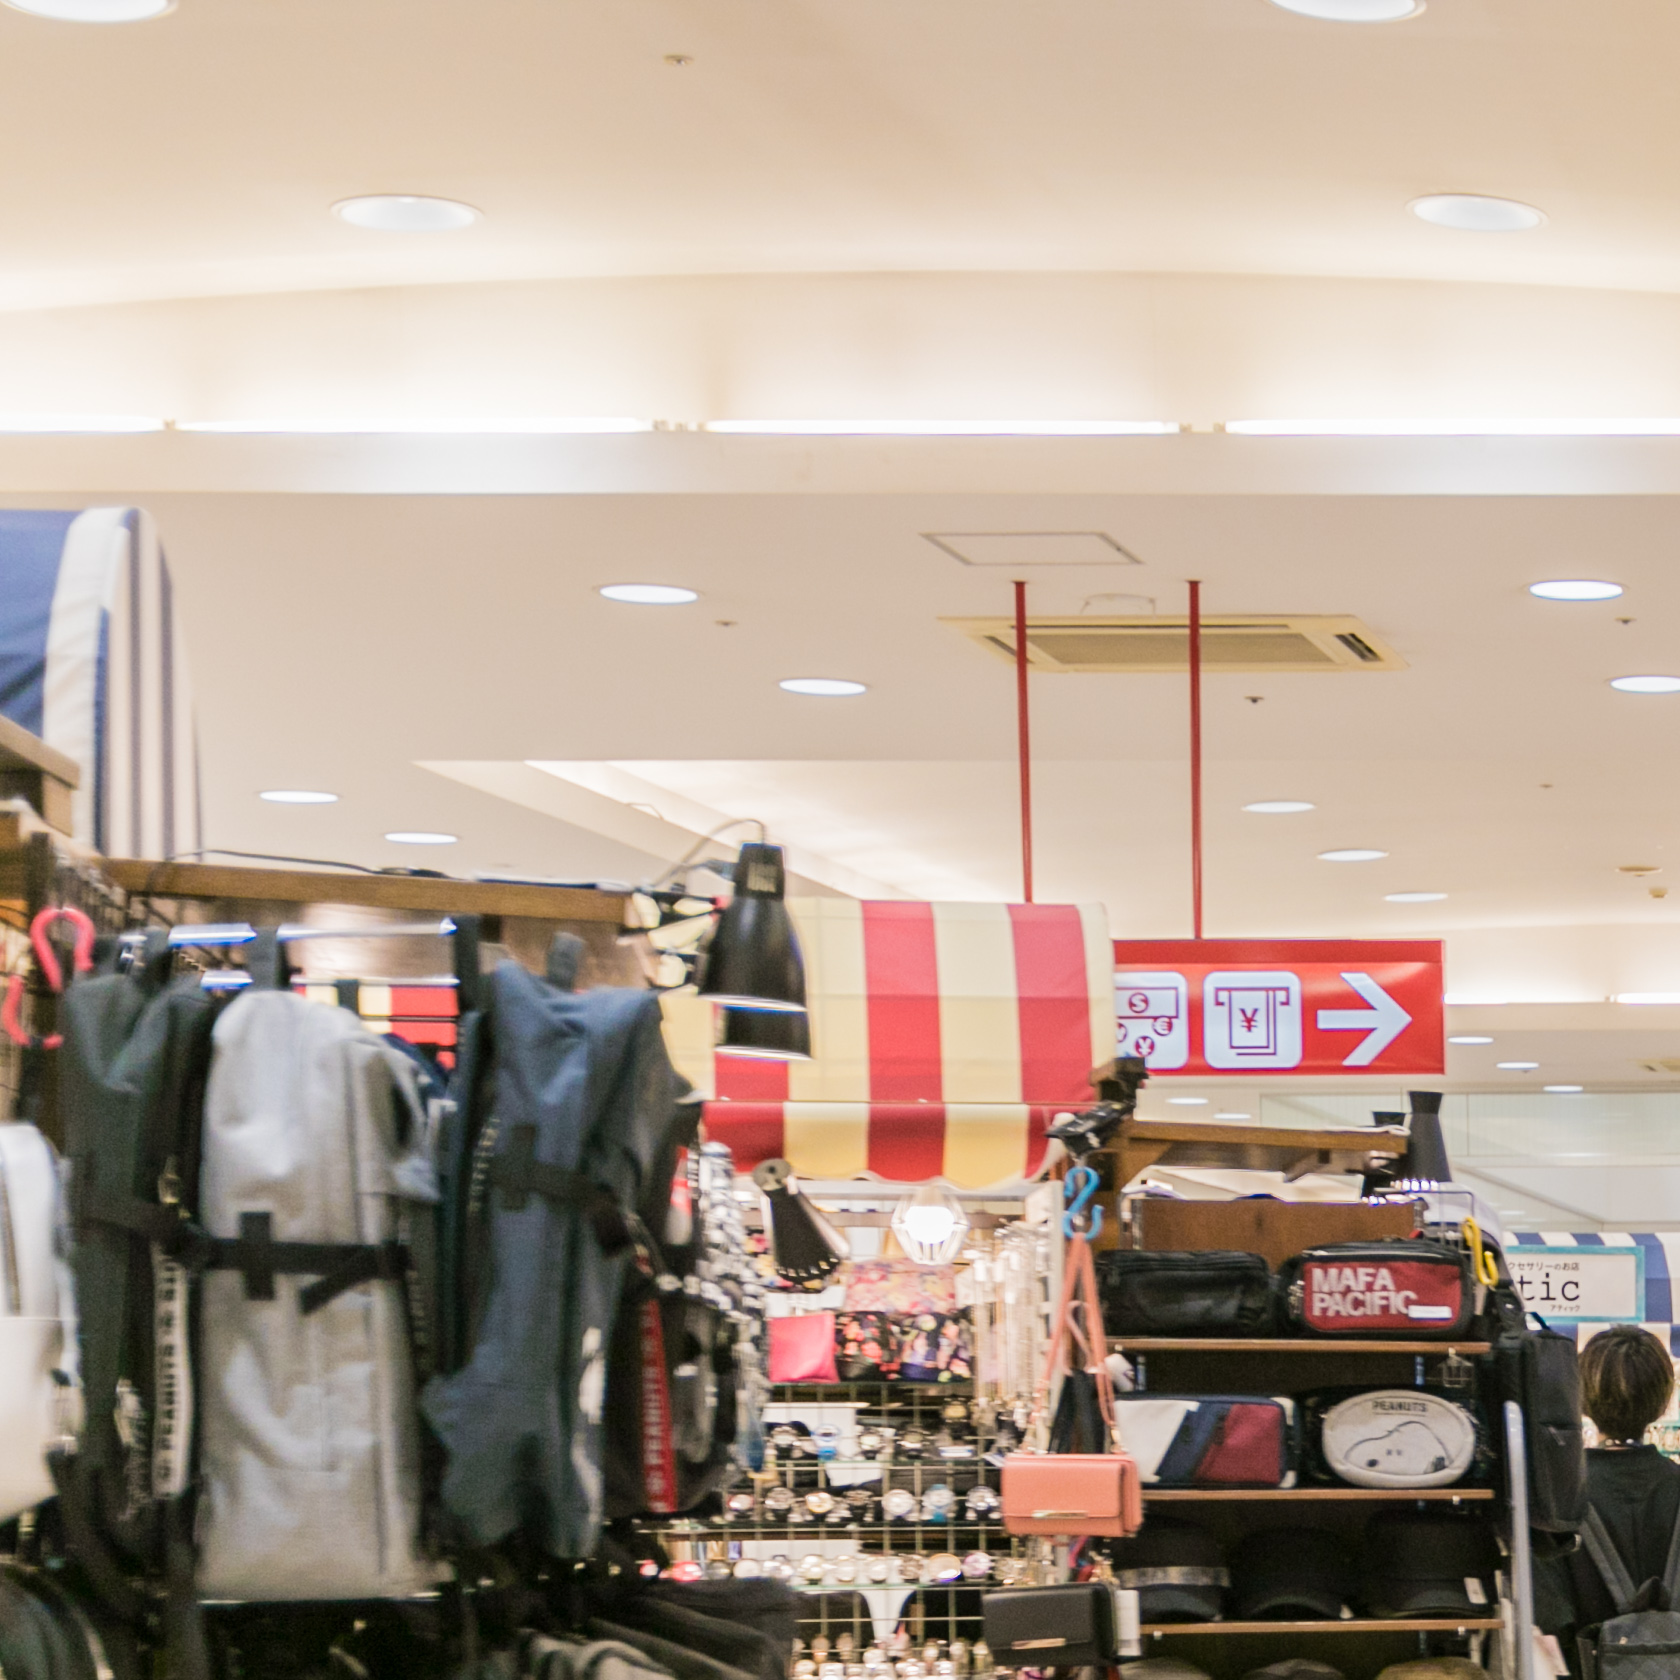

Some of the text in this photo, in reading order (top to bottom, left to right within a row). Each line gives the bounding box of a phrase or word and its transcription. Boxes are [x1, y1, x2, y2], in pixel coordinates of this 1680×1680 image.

[1311, 1267, 1396, 1293] MAFA
[1311, 1290, 1418, 1317] PACIFIC
[1371, 1400, 1427, 1412] PEANUTS
